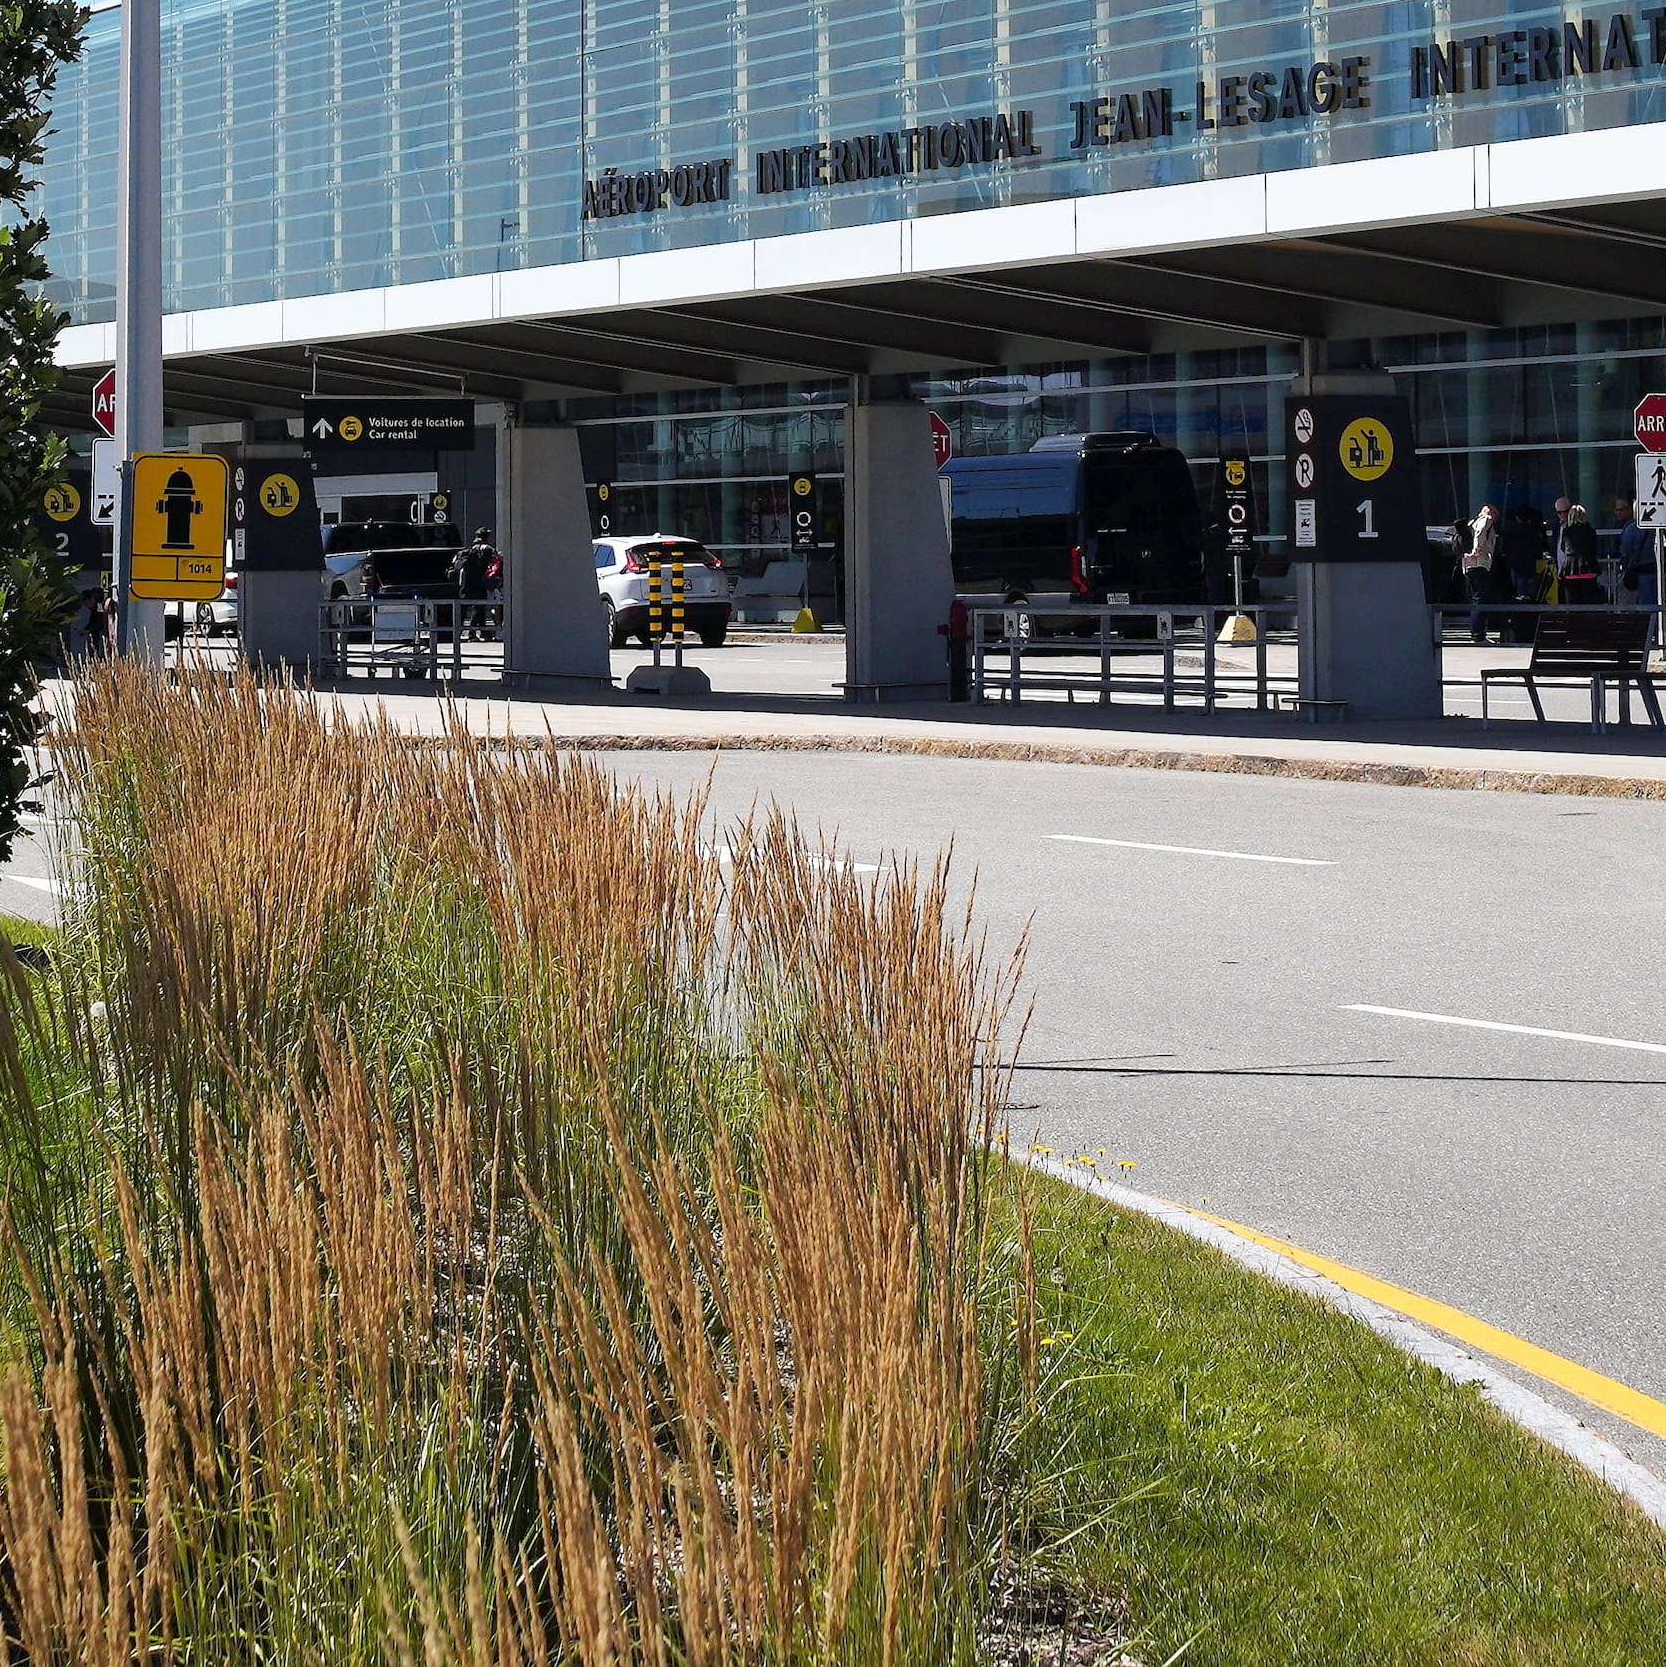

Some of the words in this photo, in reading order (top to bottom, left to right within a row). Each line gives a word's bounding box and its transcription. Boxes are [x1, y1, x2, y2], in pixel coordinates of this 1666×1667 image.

[580, 159, 733, 221] AÉROPORT
[756, 110, 1042, 194] INTERNATIONAL
[368, 417, 409, 427] Voitures
[411, 417, 423, 427] de
[426, 417, 465, 427] location
[368, 429, 386, 439] Car
[388, 429, 417, 439] rental
[410, 501, 417, 522] C
[1356, 499, 1379, 538] 1
[55, 532, 70, 556] 2
[189, 564, 212, 574] 1014
